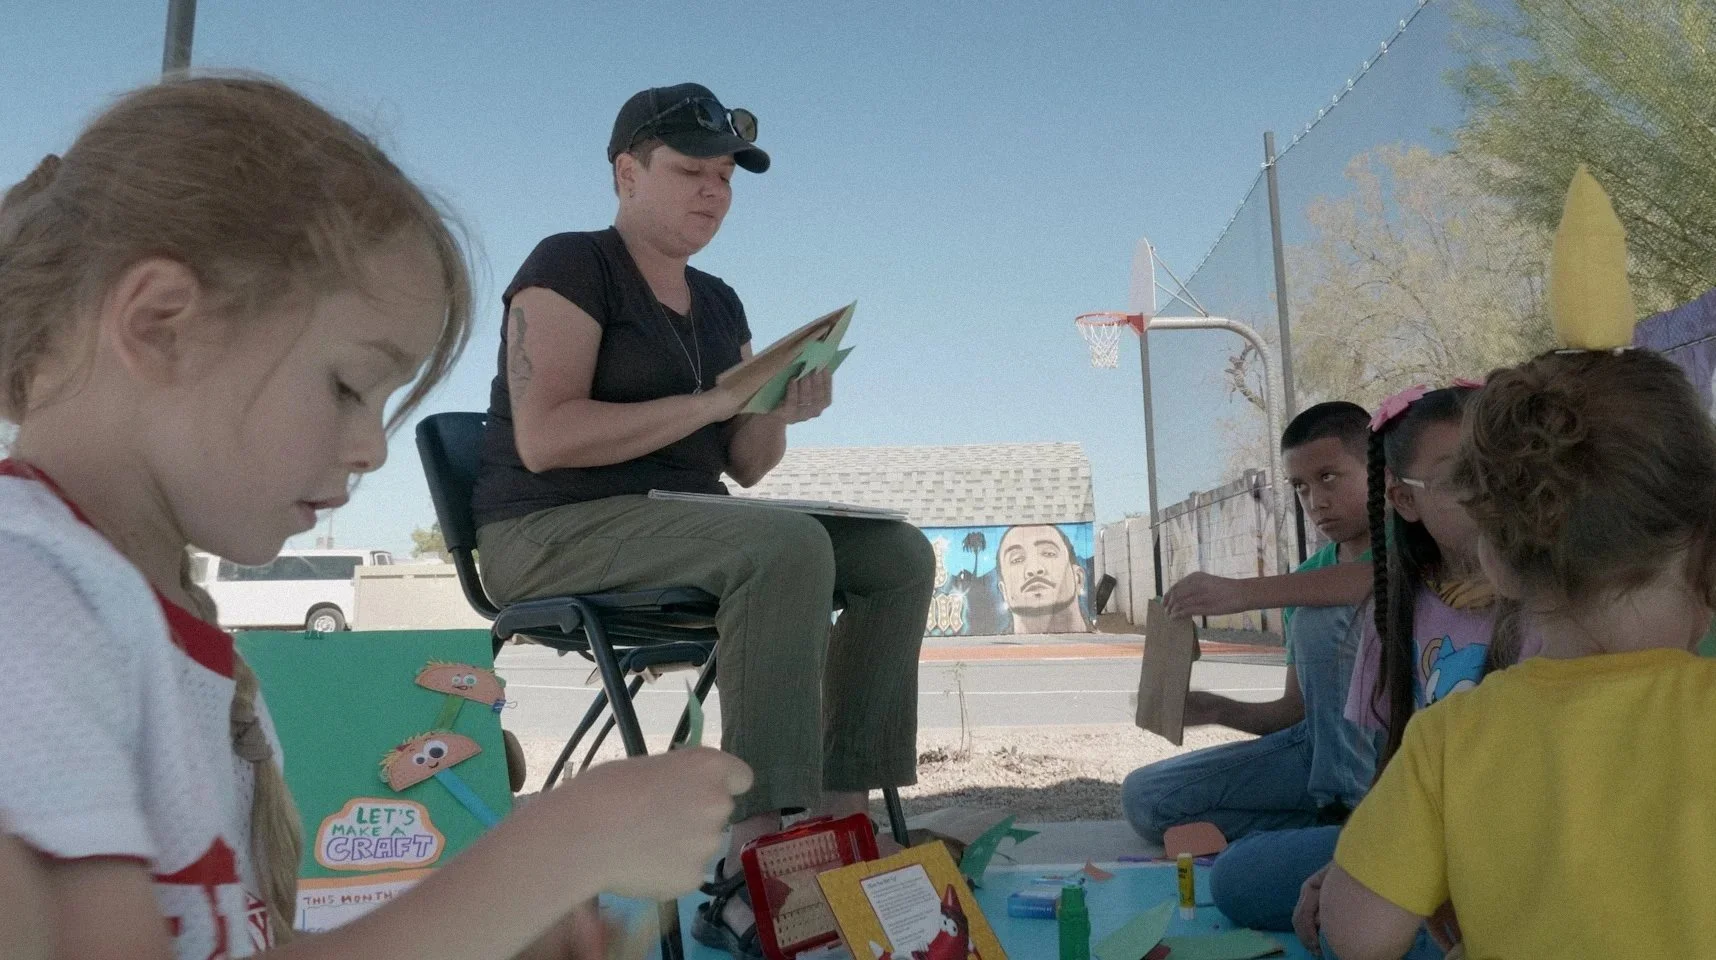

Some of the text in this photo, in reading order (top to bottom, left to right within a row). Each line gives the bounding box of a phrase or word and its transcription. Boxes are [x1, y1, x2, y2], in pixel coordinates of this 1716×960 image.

[356, 807, 415, 826] LET'S
[332, 824, 406, 837] MAKE A
[326, 834, 433, 861] CRAFT
[303, 894, 336, 905] THIS
